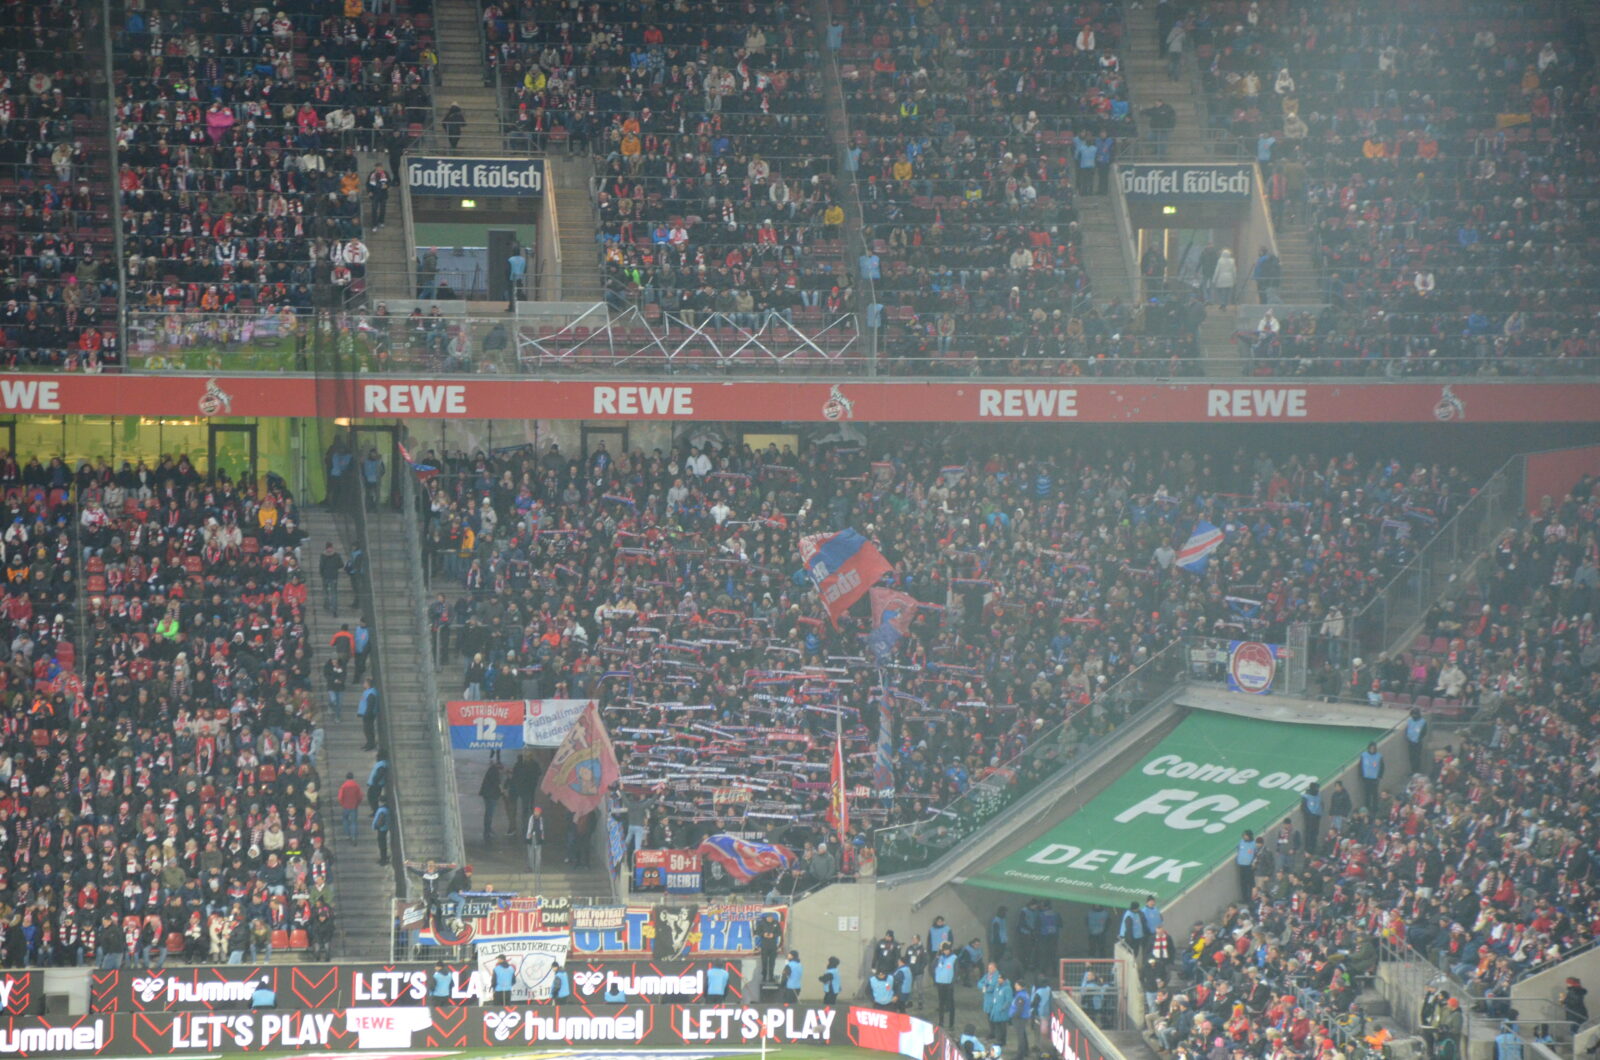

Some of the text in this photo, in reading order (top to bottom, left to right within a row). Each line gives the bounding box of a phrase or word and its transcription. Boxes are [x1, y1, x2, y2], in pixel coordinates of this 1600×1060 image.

[409, 161, 542, 192] Gaffel Kölsch
[1121, 169, 1250, 196] Gaffel Kölsch
[364, 385, 466, 413] REWE
[593, 386, 693, 414] REWE
[979, 389, 1078, 417] REWE
[1207, 389, 1307, 417] REWE
[460, 704, 509, 719] OSTTRIBÜNE
[473, 717, 497, 740] 12
[535, 719, 575, 741] Heidenh
[469, 741, 504, 749] MANN
[1142, 754, 1319, 794] Come on
[1114, 788, 1270, 834] FC!
[669, 854, 697, 871] 50+1
[1026, 843, 1203, 883] DEVK
[667, 873, 700, 889] BLEIBT!
[460, 902, 491, 916] REW
[573, 909, 590, 919] LOVE
[698, 911, 780, 952] RA
[480, 941, 567, 955] KLEINSTADTKRIEGER
[167, 975, 269, 1002] humme
[355, 971, 427, 1001] LET'S
[607, 969, 703, 995] hummel
[172, 1013, 334, 1048] LET'S PLAY
[525, 1009, 643, 1041] hummel
[682, 1008, 836, 1040] LET'S PLAY
